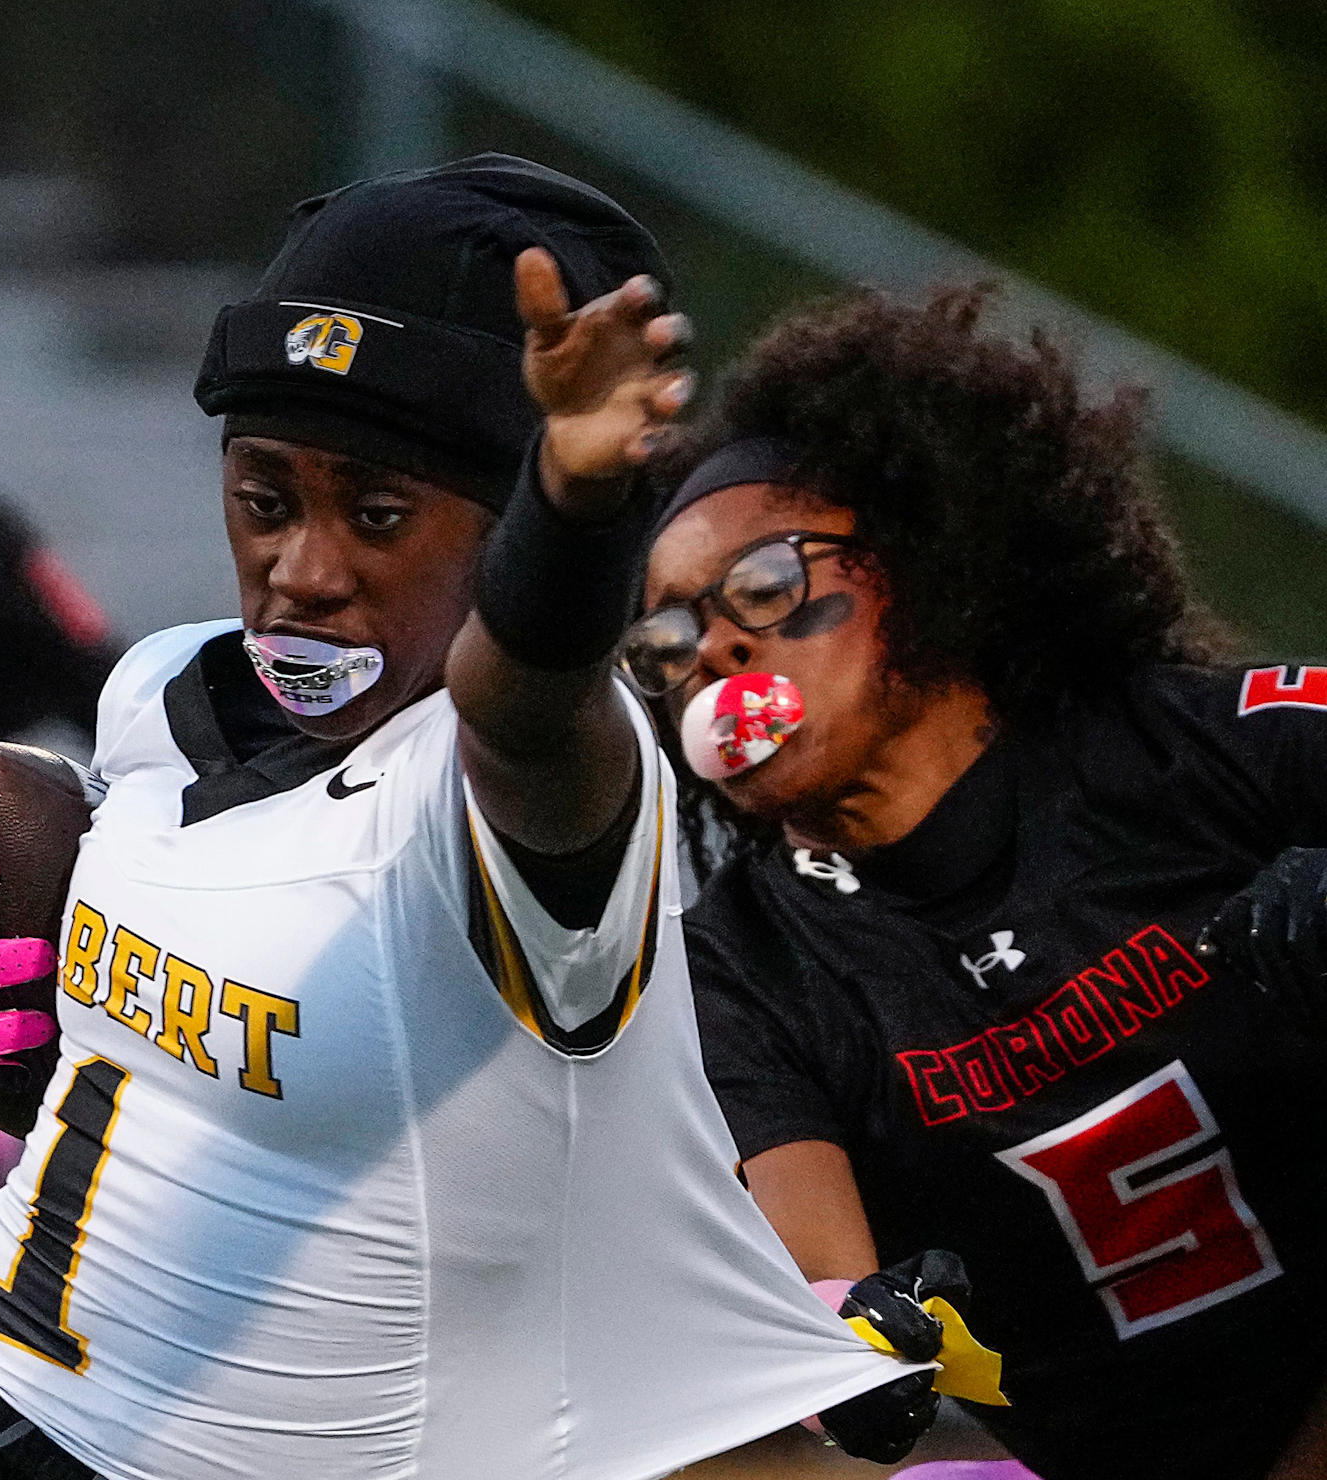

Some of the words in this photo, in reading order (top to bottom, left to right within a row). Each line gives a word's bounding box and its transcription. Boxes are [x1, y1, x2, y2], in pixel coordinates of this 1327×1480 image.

[59, 899, 301, 1101] BERT
[897, 923, 1212, 1126] CORONA
[993, 1058, 1285, 1341] 5
